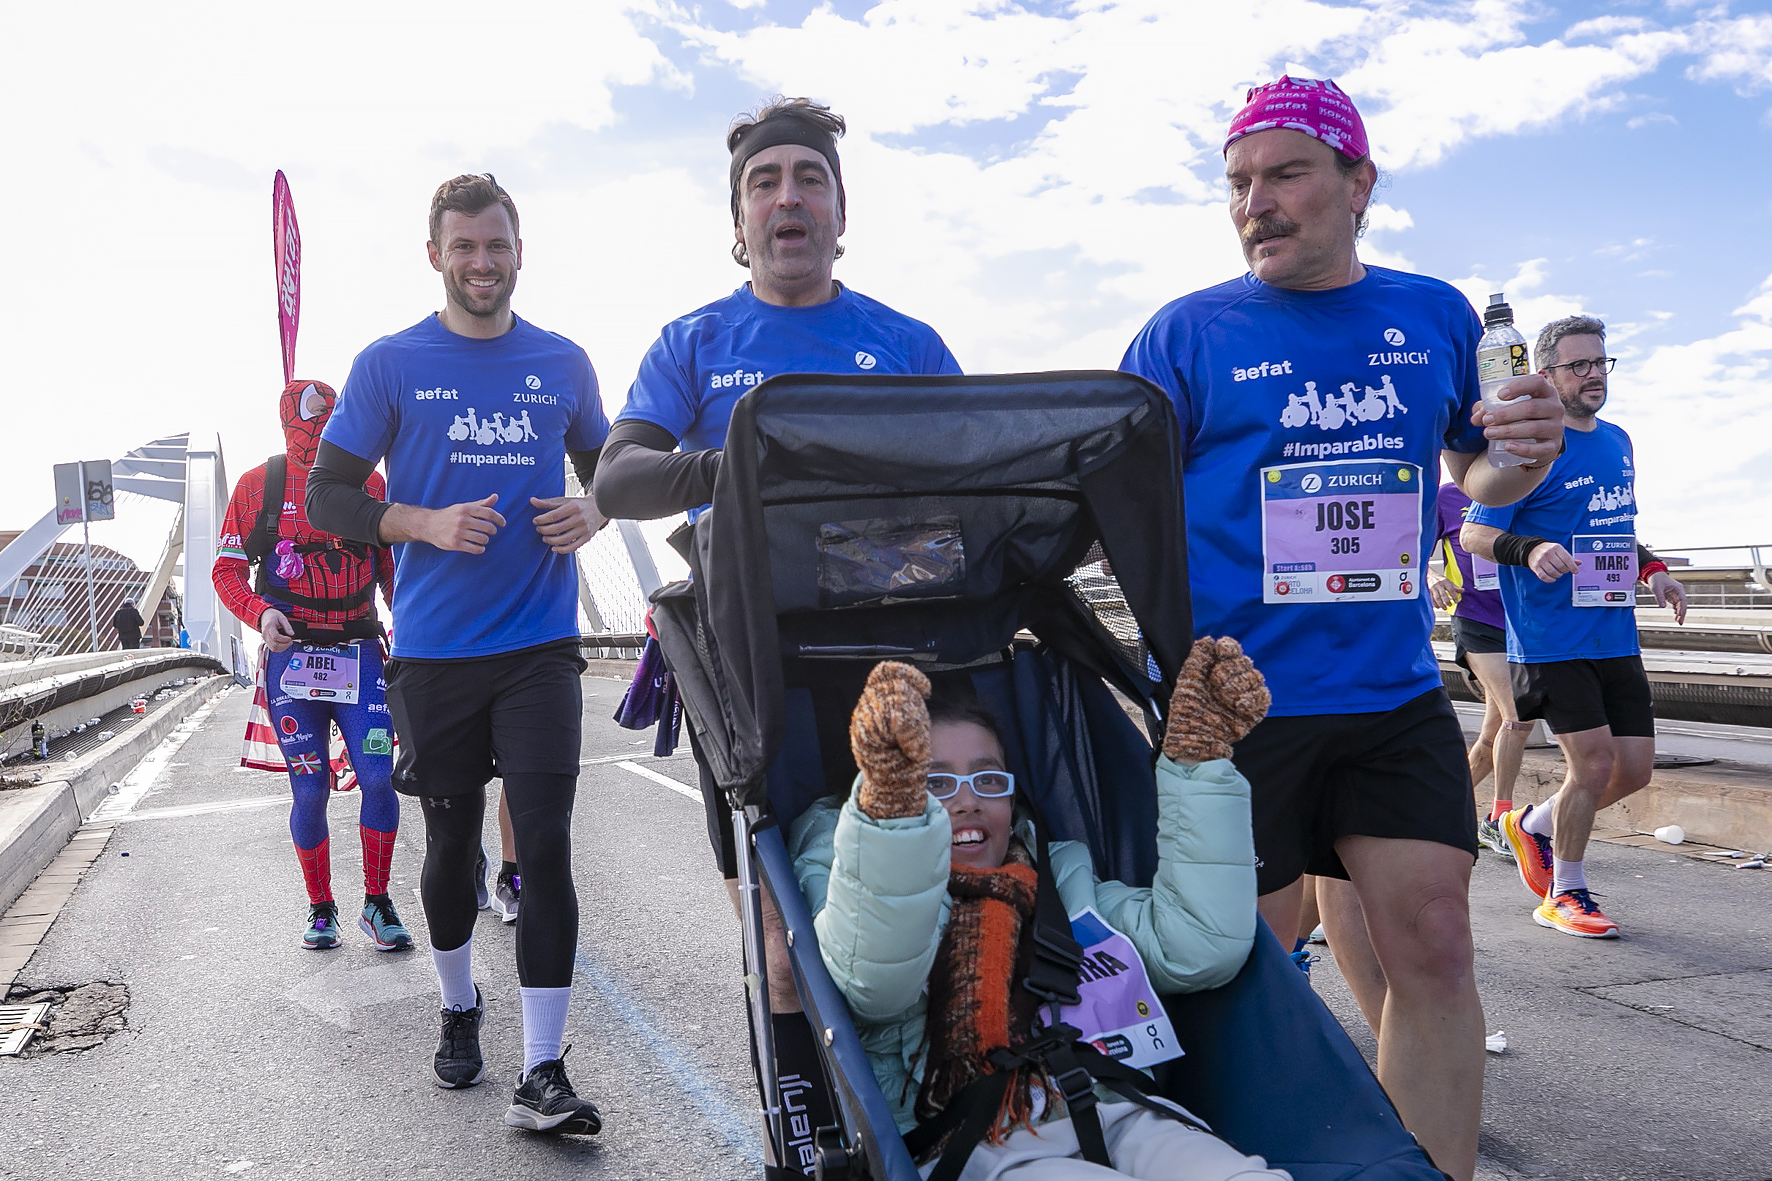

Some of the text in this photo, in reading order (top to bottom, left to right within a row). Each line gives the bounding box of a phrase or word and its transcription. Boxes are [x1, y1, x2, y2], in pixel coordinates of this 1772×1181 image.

[1265, 102, 1308, 111] aefat
[1320, 96, 1353, 114] aefat
[1319, 107, 1354, 127] KOPAS
[1319, 123, 1353, 143] aefat
[1368, 351, 1429, 366] ZURICH
[1233, 360, 1293, 382] aefat
[711, 369, 764, 389] aefat
[415, 388, 459, 401] aefat
[513, 393, 557, 405] ZURICH
[1283, 433, 1405, 459] #Imparables
[450, 452, 536, 467] #Imparables
[1328, 474, 1383, 487] ZURICH
[1565, 475, 1595, 490] aefat
[1315, 500, 1376, 532] JOSE
[1331, 537, 1361, 555] 305
[1595, 556, 1629, 571] MARC
[1606, 574, 1620, 582] 493
[306, 656, 337, 671] ABEL
[313, 672, 328, 681] 482
